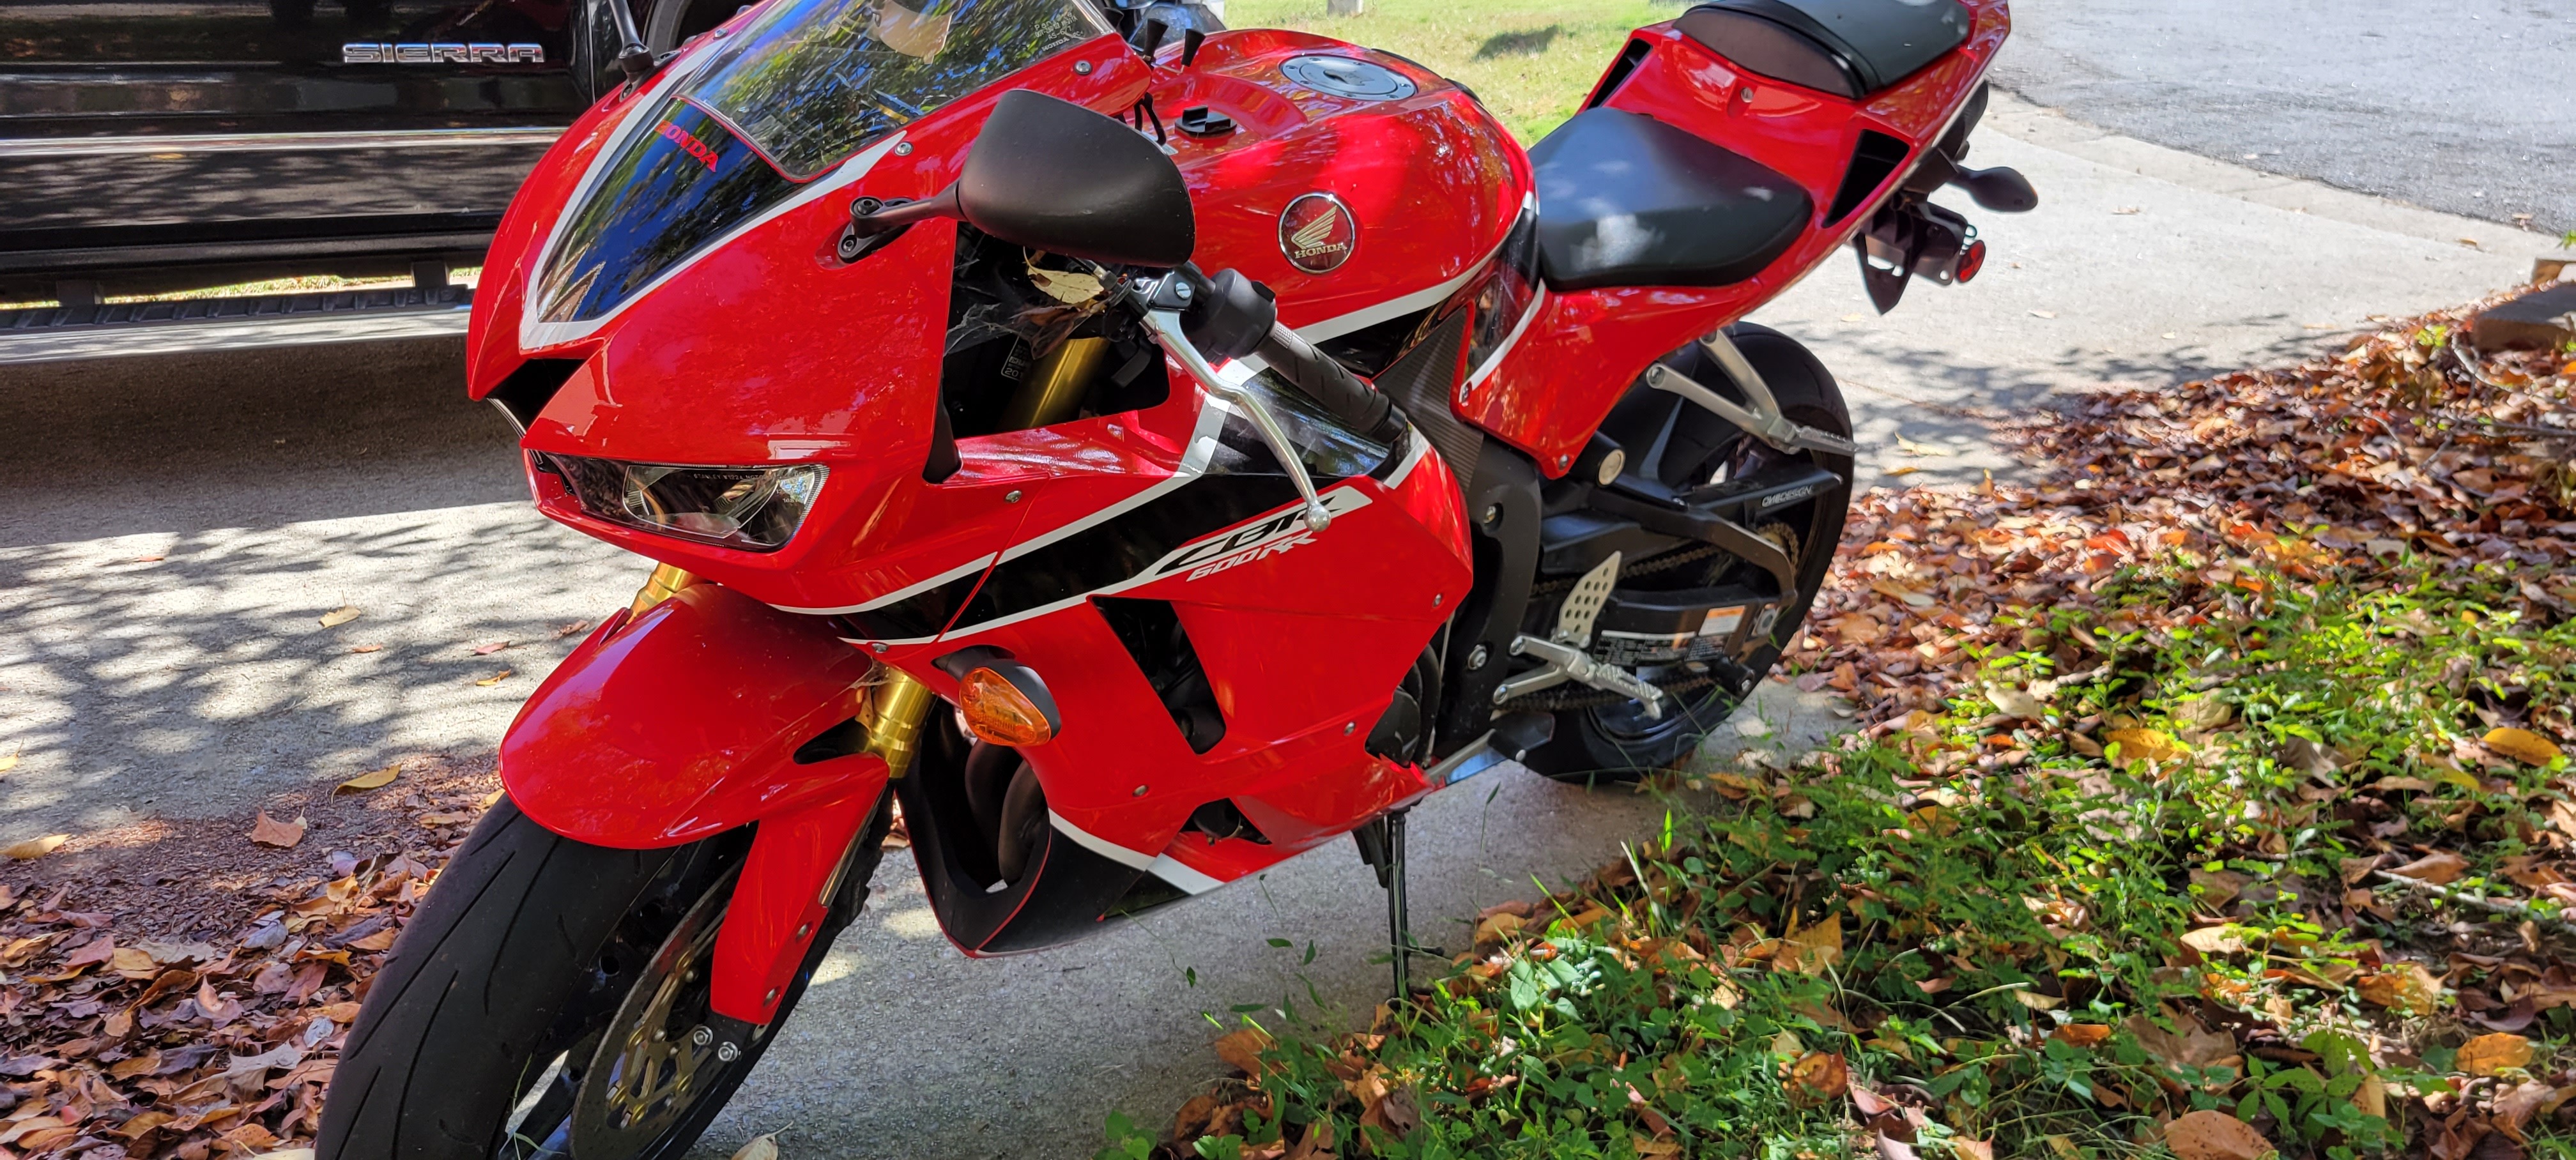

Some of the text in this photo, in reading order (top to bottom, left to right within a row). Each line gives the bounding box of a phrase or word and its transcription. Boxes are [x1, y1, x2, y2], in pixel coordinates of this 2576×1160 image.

[342, 43, 544, 63] SIERRA
[654, 119, 718, 172] HONDA
[1294, 242, 1347, 259] HONDA
[1186, 530, 1318, 583] 600RR
